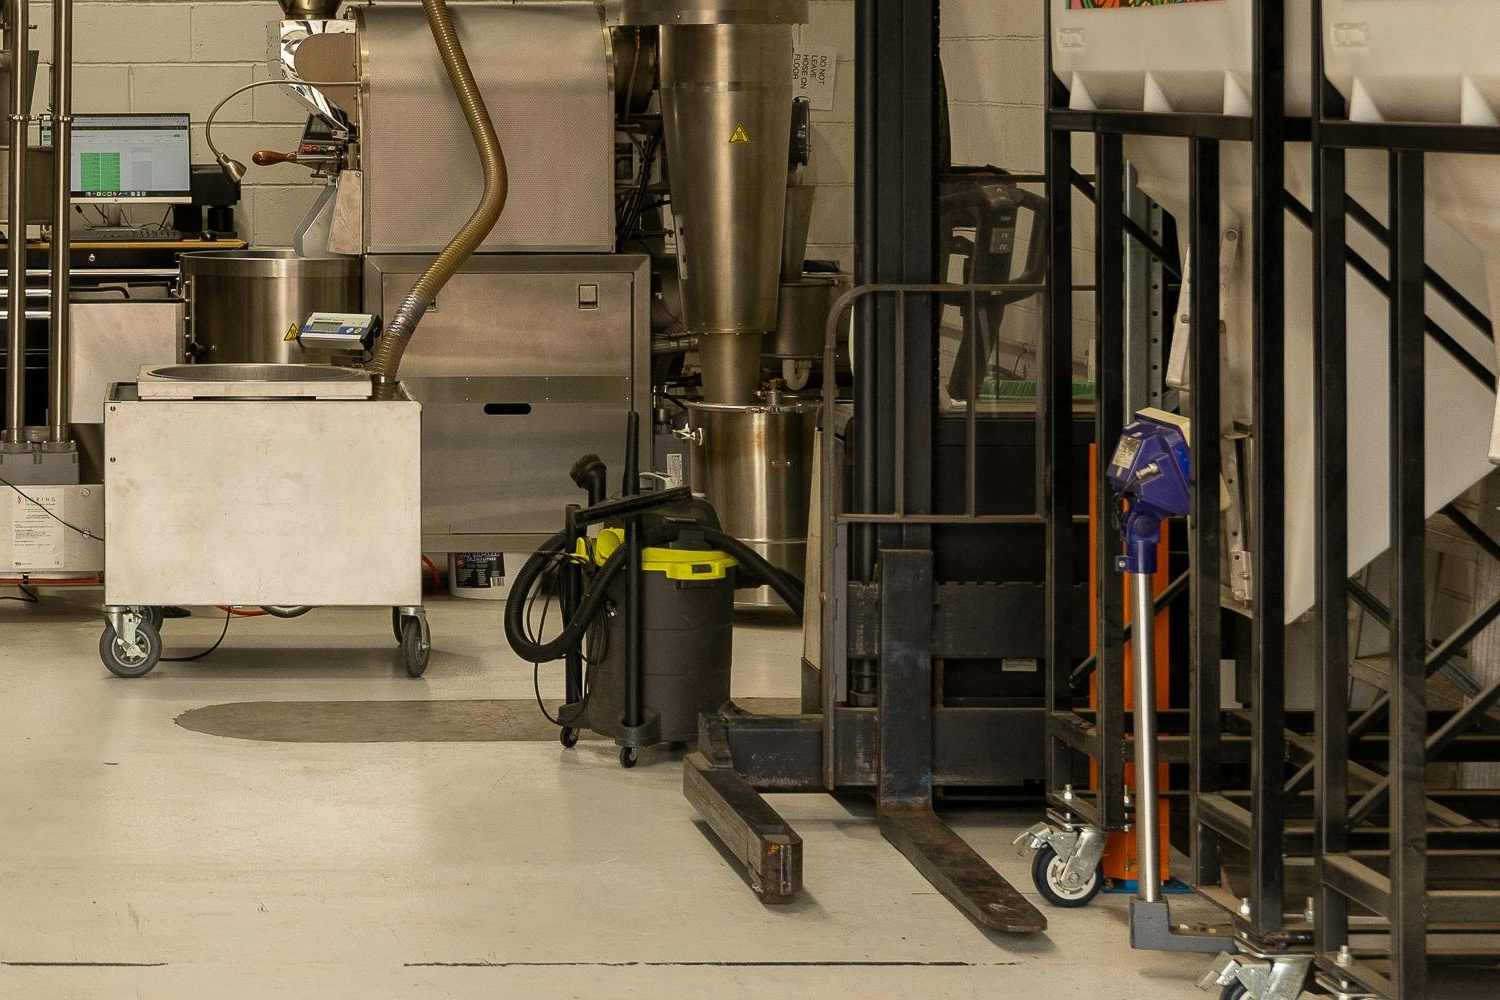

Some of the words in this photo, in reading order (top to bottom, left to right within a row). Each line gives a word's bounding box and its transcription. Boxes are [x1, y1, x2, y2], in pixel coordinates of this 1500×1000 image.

[810, 55, 818, 79] LEAVE
[820, 55, 827, 66] DO
[800, 77, 807, 89] ON
[818, 69, 826, 85] NOT
